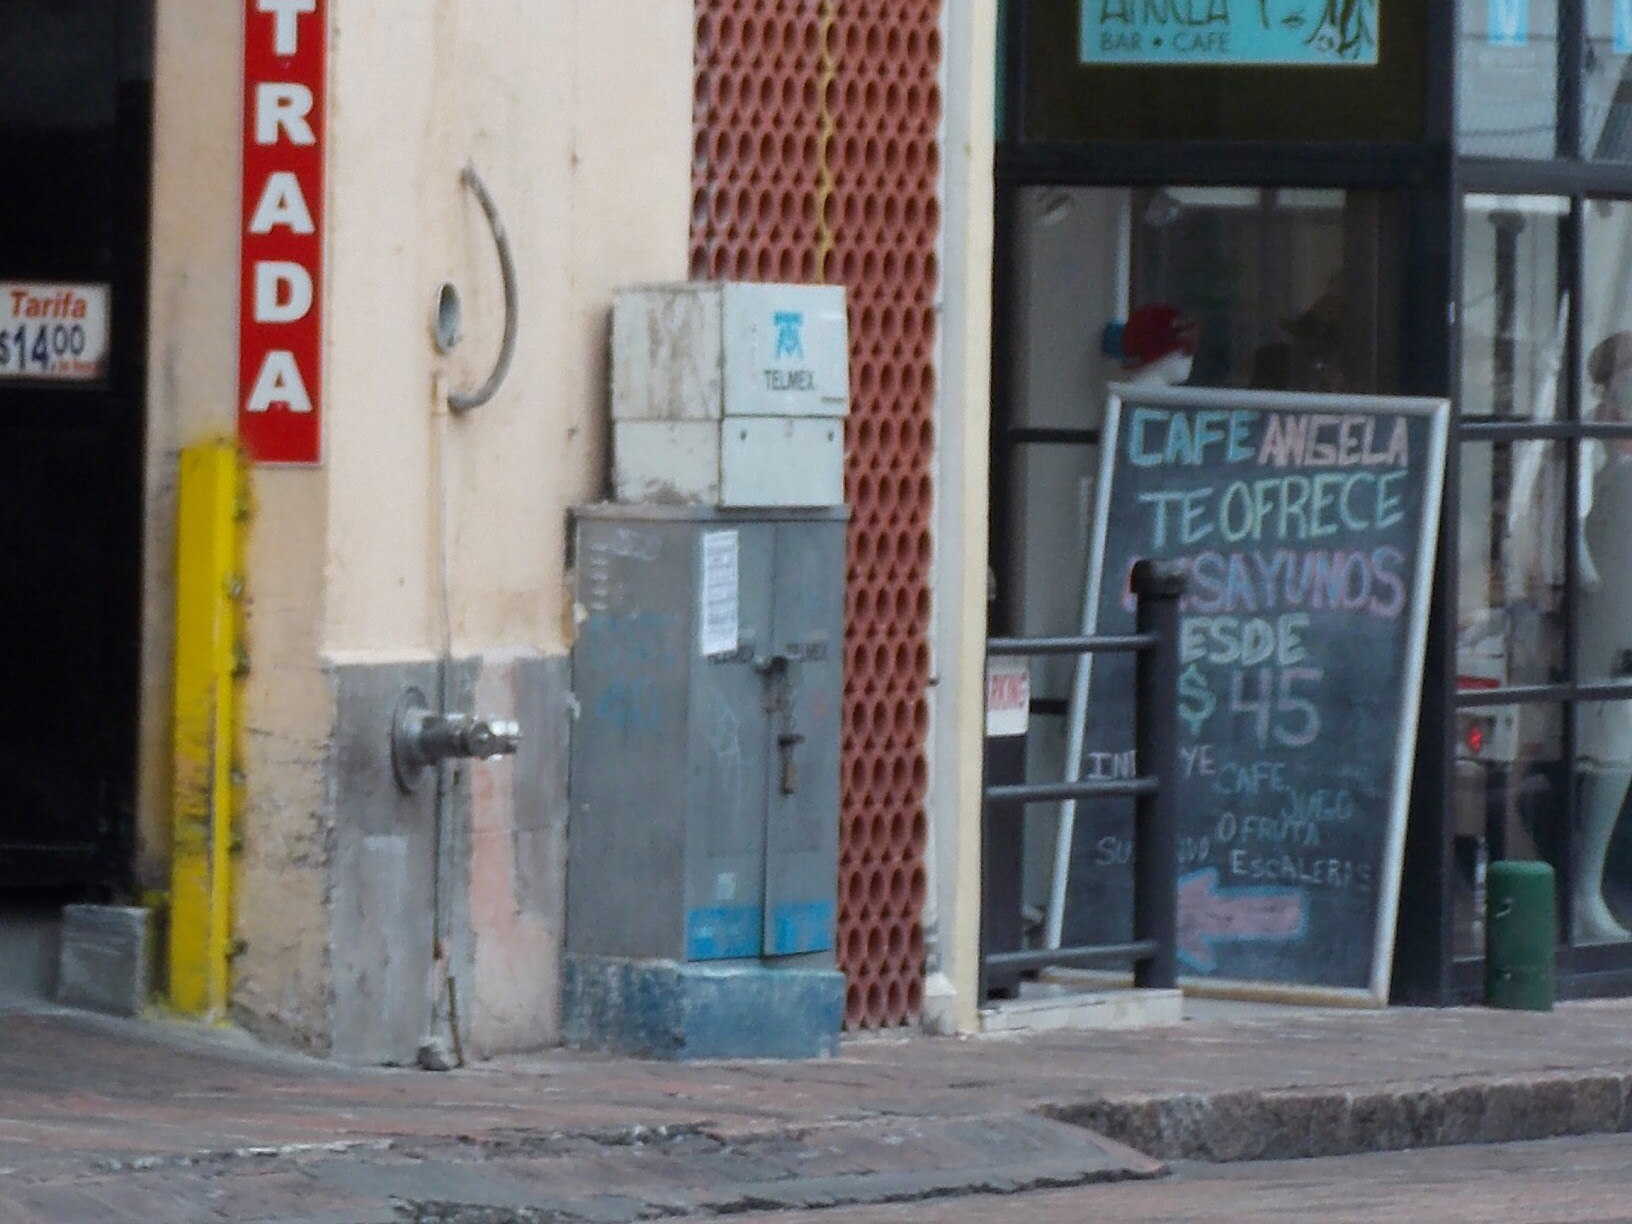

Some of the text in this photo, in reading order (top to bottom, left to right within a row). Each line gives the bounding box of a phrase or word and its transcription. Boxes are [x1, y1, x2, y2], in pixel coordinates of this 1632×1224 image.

[1099, 30, 1142, 52] BAR
[11, 290, 87, 319] Tarifa
[763, 369, 816, 392] TELMEX
[1129, 408, 1409, 467] CAFE ANGELA
[1138, 470, 1409, 553] TE OFRECE
[1178, 612, 1311, 667] ESDE
